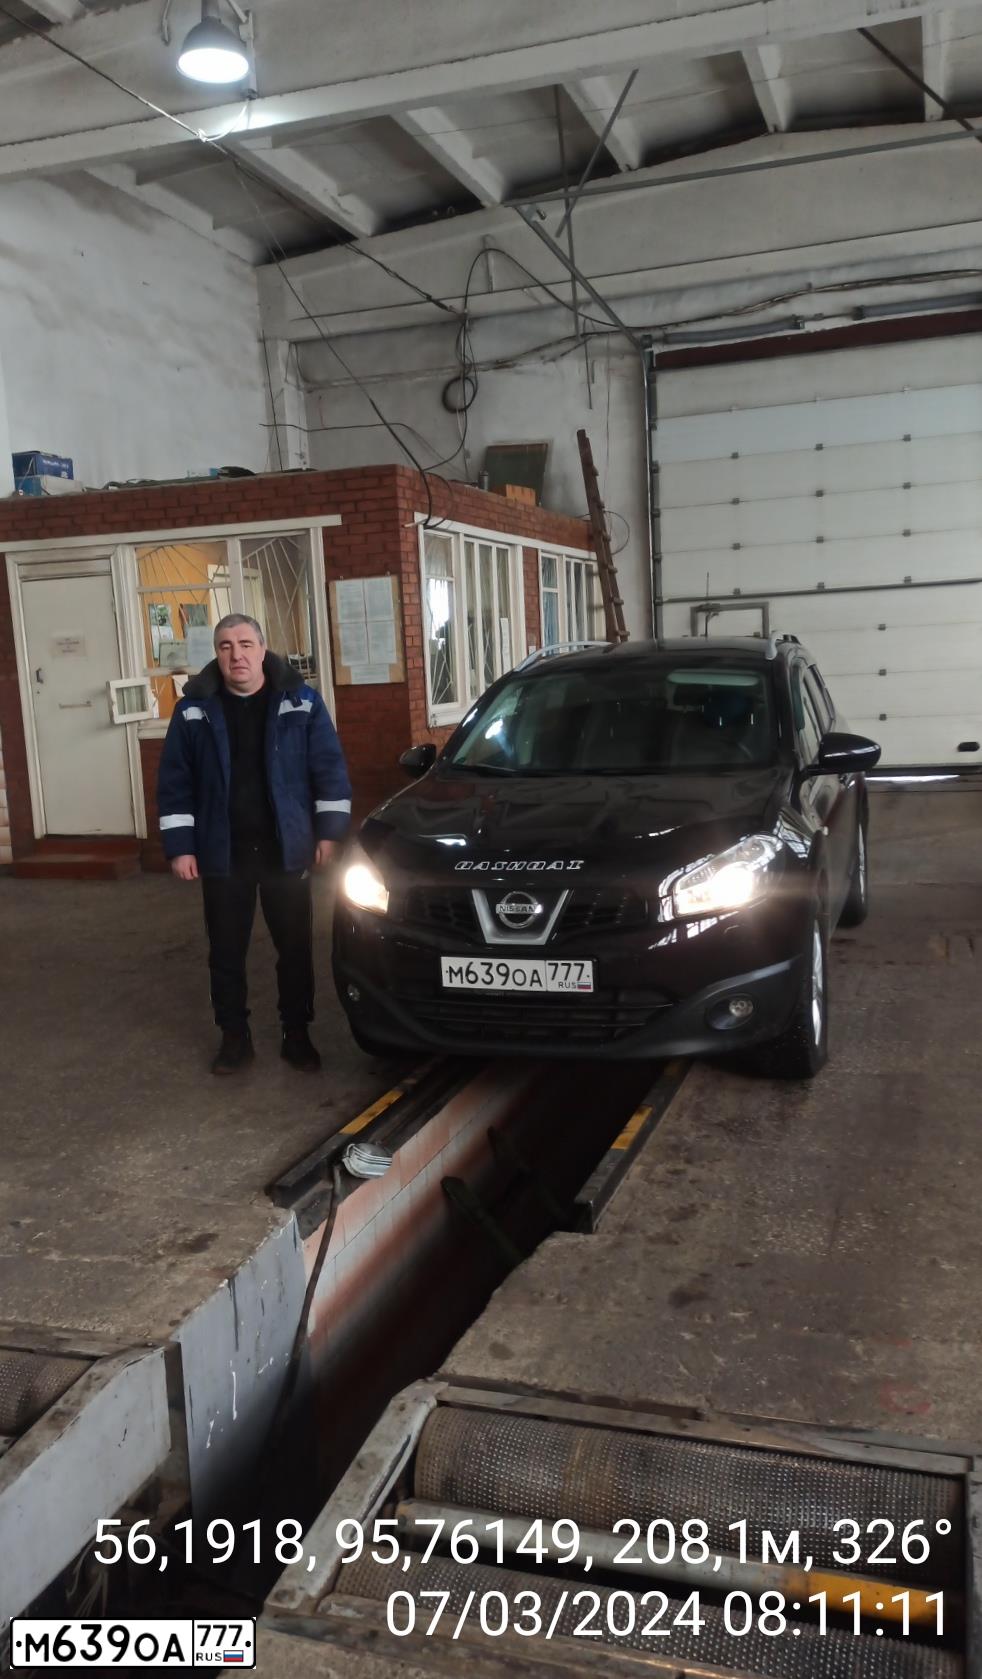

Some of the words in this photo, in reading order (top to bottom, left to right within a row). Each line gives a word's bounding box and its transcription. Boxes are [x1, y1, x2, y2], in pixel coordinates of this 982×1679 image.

[499, 905, 536, 913] NISSAN
[547, 963, 585, 981] 777
[558, 981, 577, 989] RUS
